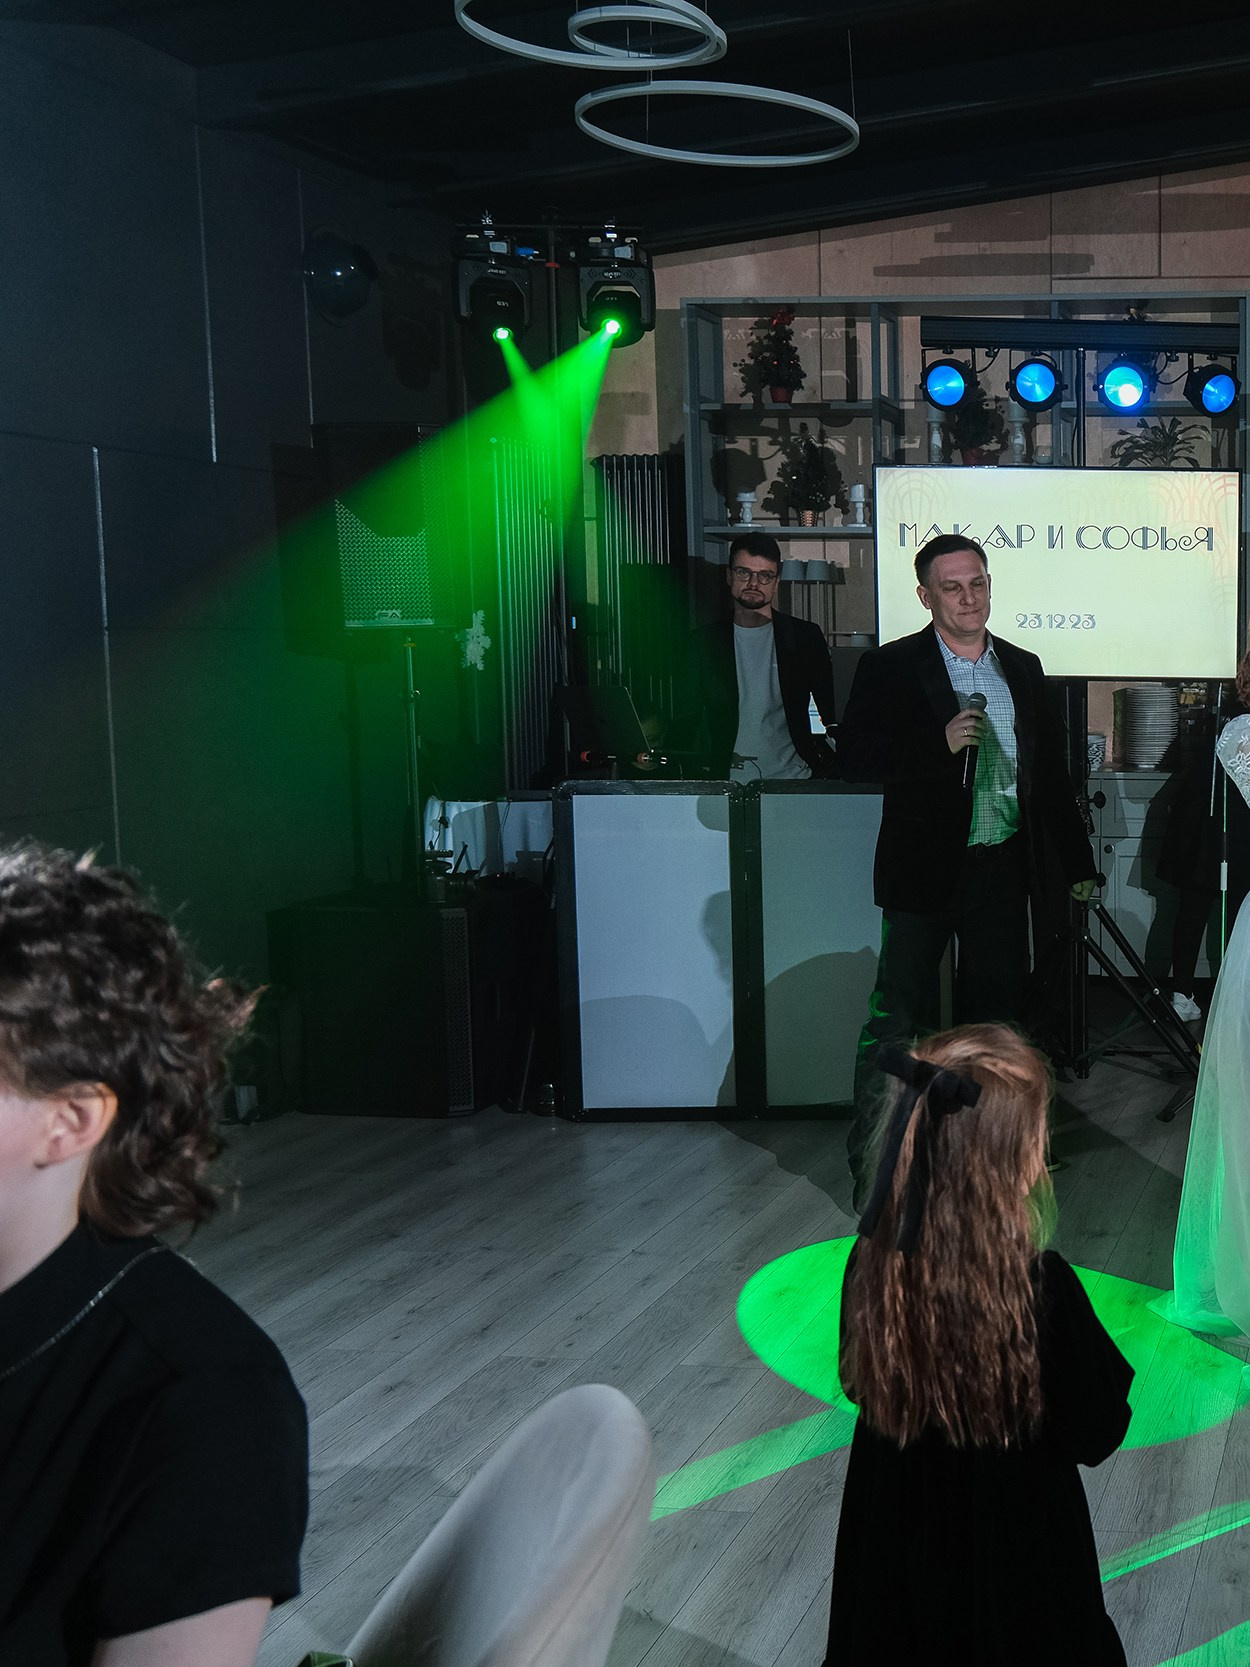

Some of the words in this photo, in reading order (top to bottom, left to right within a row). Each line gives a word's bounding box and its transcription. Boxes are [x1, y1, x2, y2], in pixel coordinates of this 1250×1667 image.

[1047, 524, 1064, 550] И
[1075, 524, 1214, 551] СОФЬЯ
[1015, 612, 1097, 631] 23.12.23
